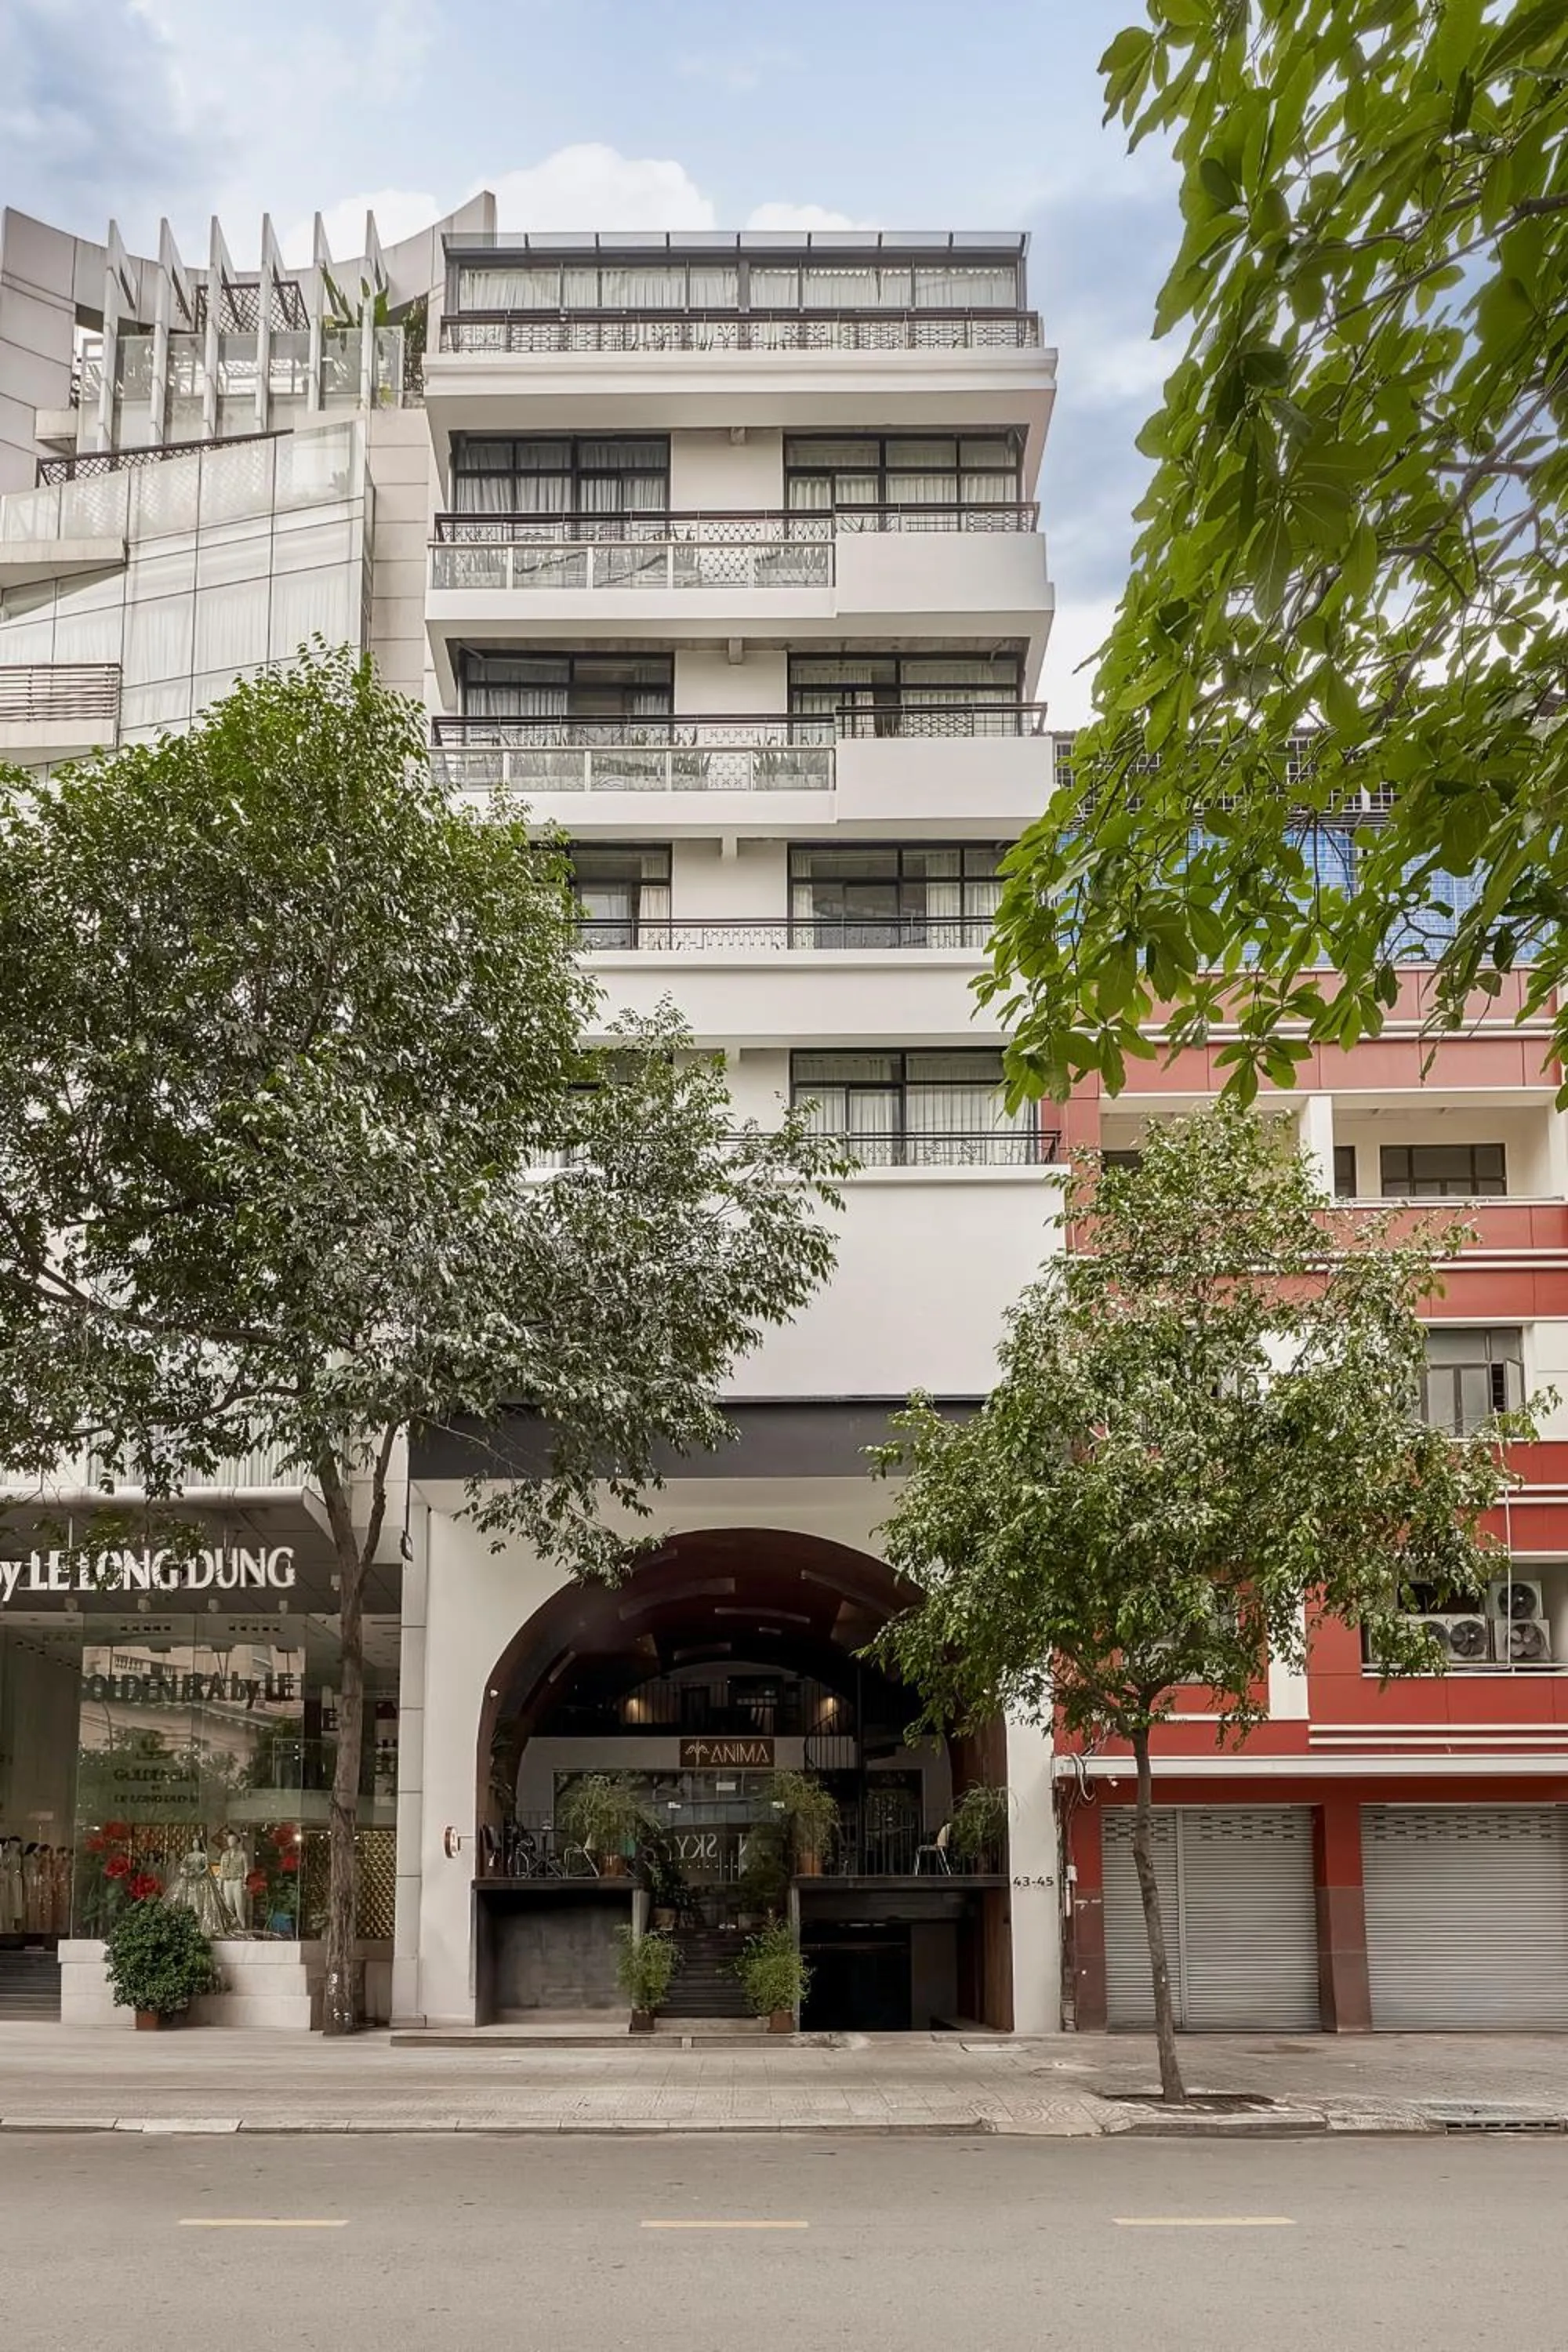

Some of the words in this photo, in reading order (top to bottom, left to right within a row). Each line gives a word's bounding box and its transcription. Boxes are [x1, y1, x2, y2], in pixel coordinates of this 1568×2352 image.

[0, 1561, 22, 1602] y
[31, 1550, 70, 1591] LE
[77, 1549, 179, 1592] LONG
[187, 1547, 296, 1589] DUNG
[710, 1743, 770, 1763] ANIMA
[1013, 1876, 1054, 1887] 43-45
